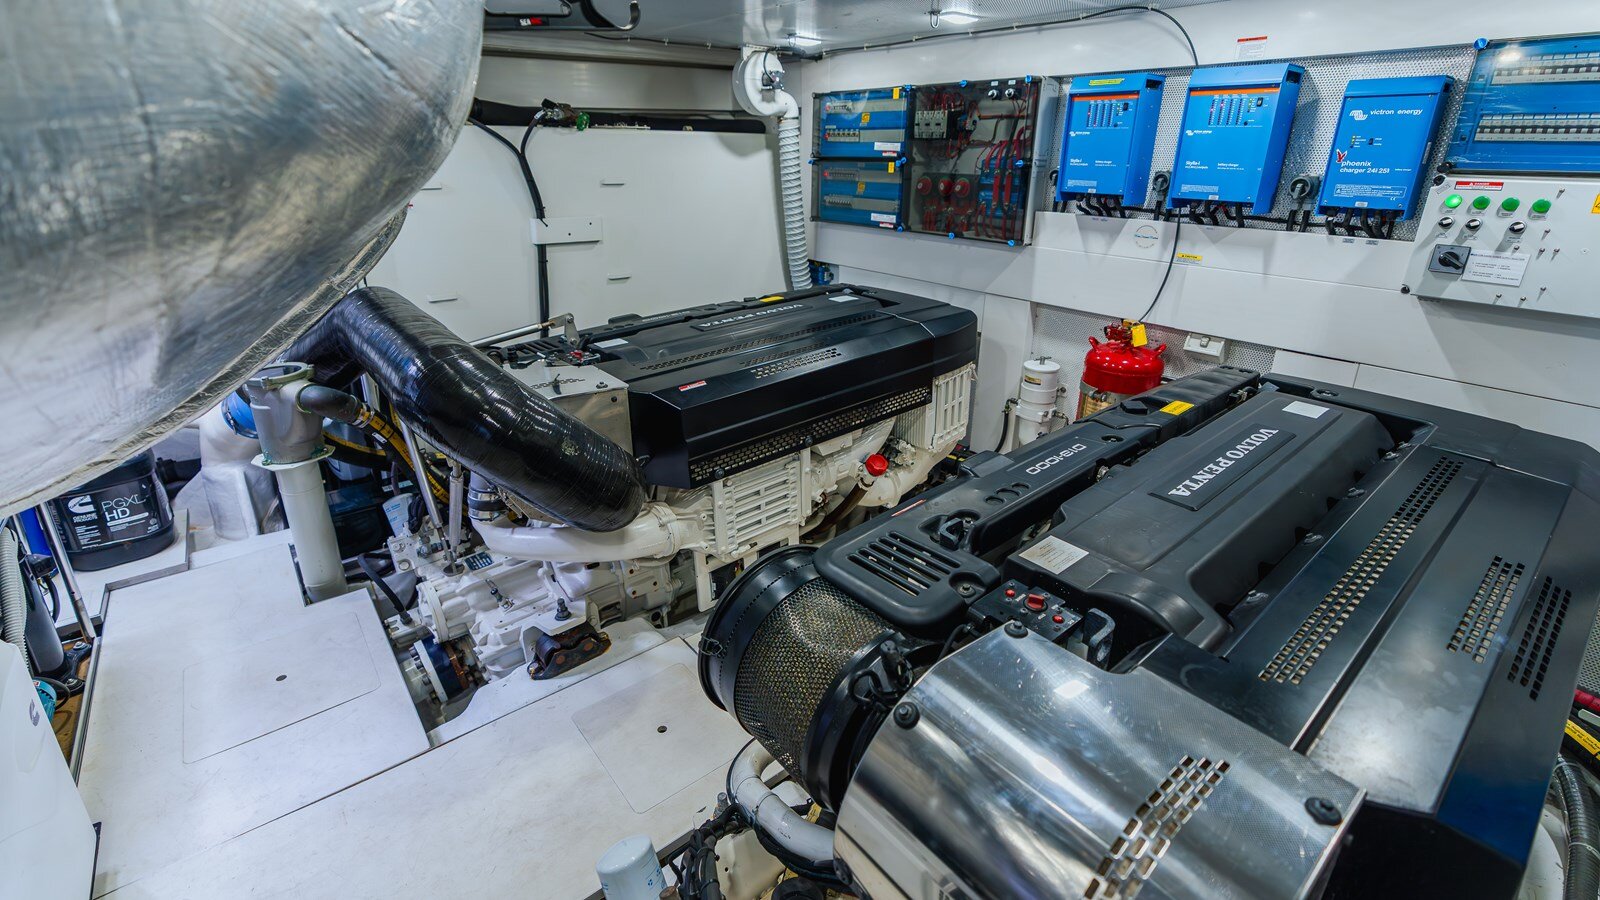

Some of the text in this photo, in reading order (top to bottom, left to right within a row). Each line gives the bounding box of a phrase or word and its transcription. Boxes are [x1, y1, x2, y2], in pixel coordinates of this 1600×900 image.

[1168, 428, 1279, 497] VOLVO PENTA
[105, 508, 130, 521] HD
